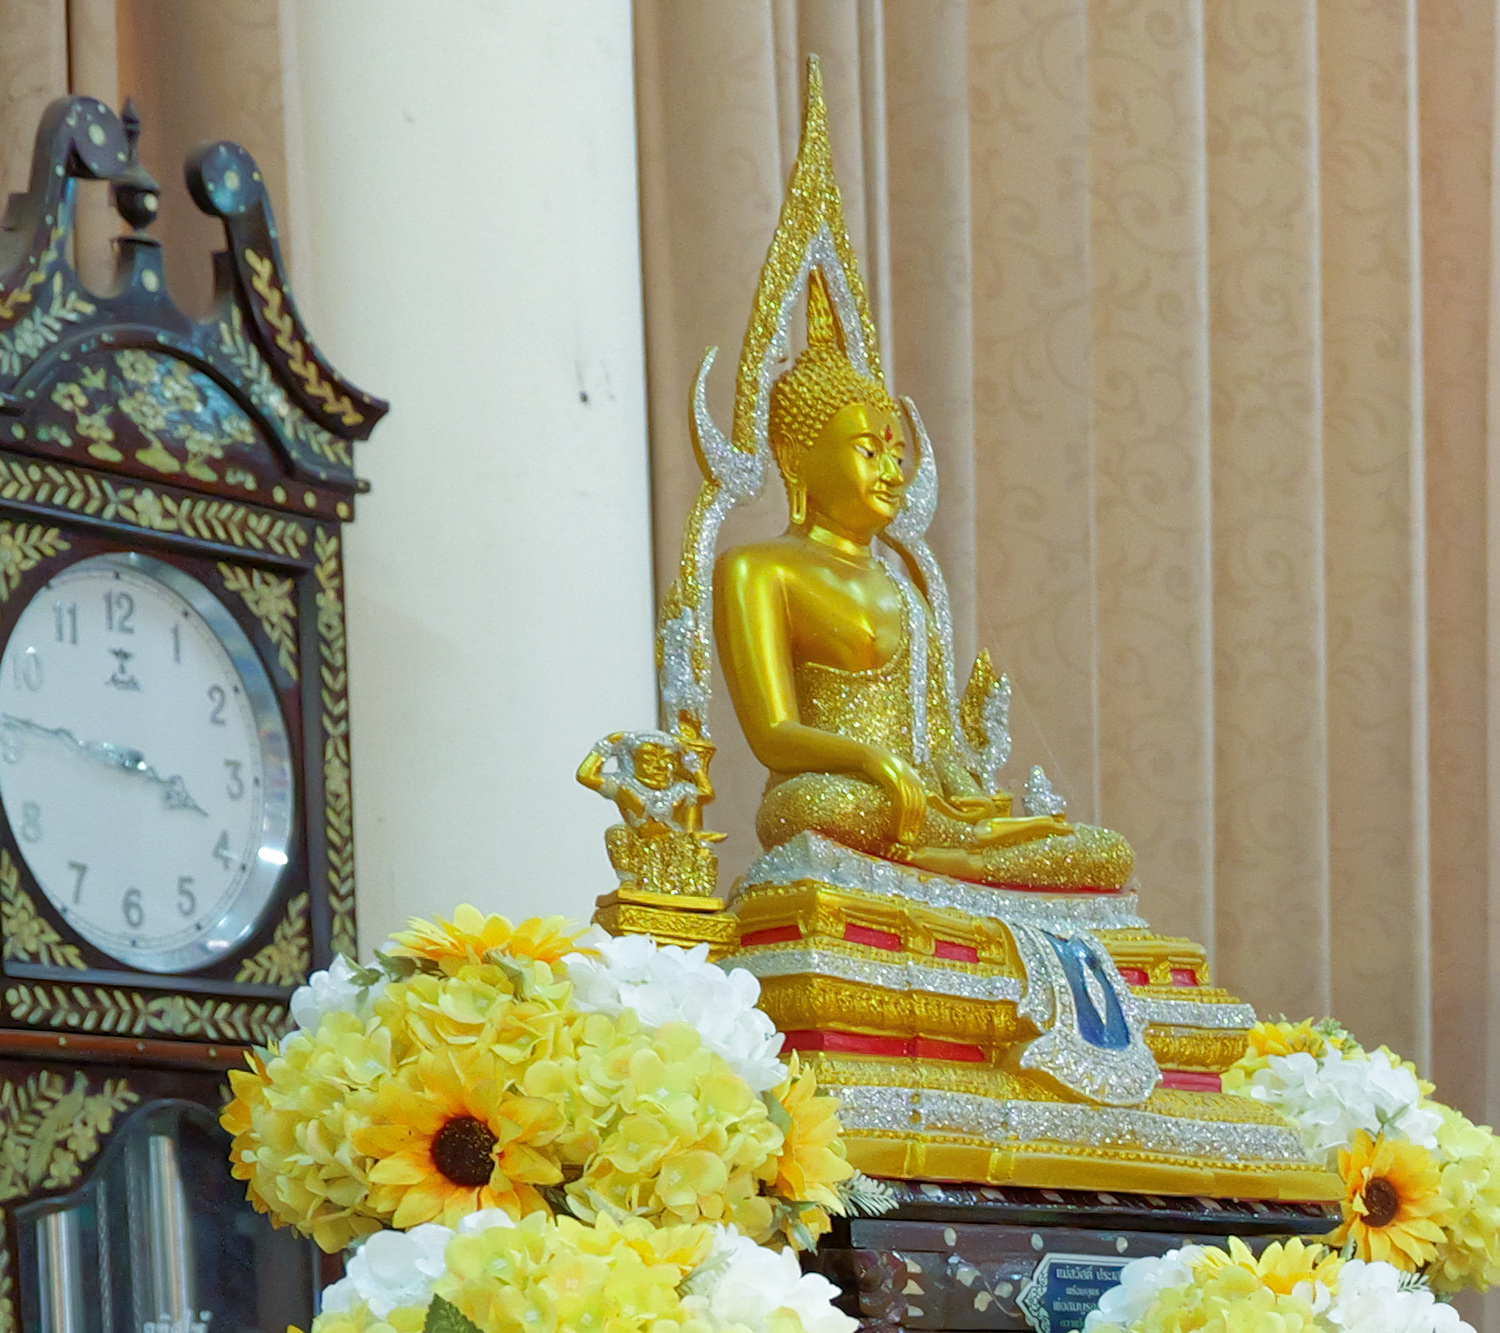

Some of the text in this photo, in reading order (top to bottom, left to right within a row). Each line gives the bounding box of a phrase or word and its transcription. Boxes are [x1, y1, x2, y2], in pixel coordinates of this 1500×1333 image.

[53, 601, 78, 645] 11
[103, 589, 135, 634] 12
[169, 623, 181, 665] 1
[11, 650, 44, 692] 10
[207, 684, 226, 726] 2
[223, 758, 245, 801] 3
[21, 800, 41, 844] 8
[212, 829, 235, 870] 4
[68, 860, 88, 905] 7
[177, 875, 197, 917] 5
[121, 887, 144, 929] 6
